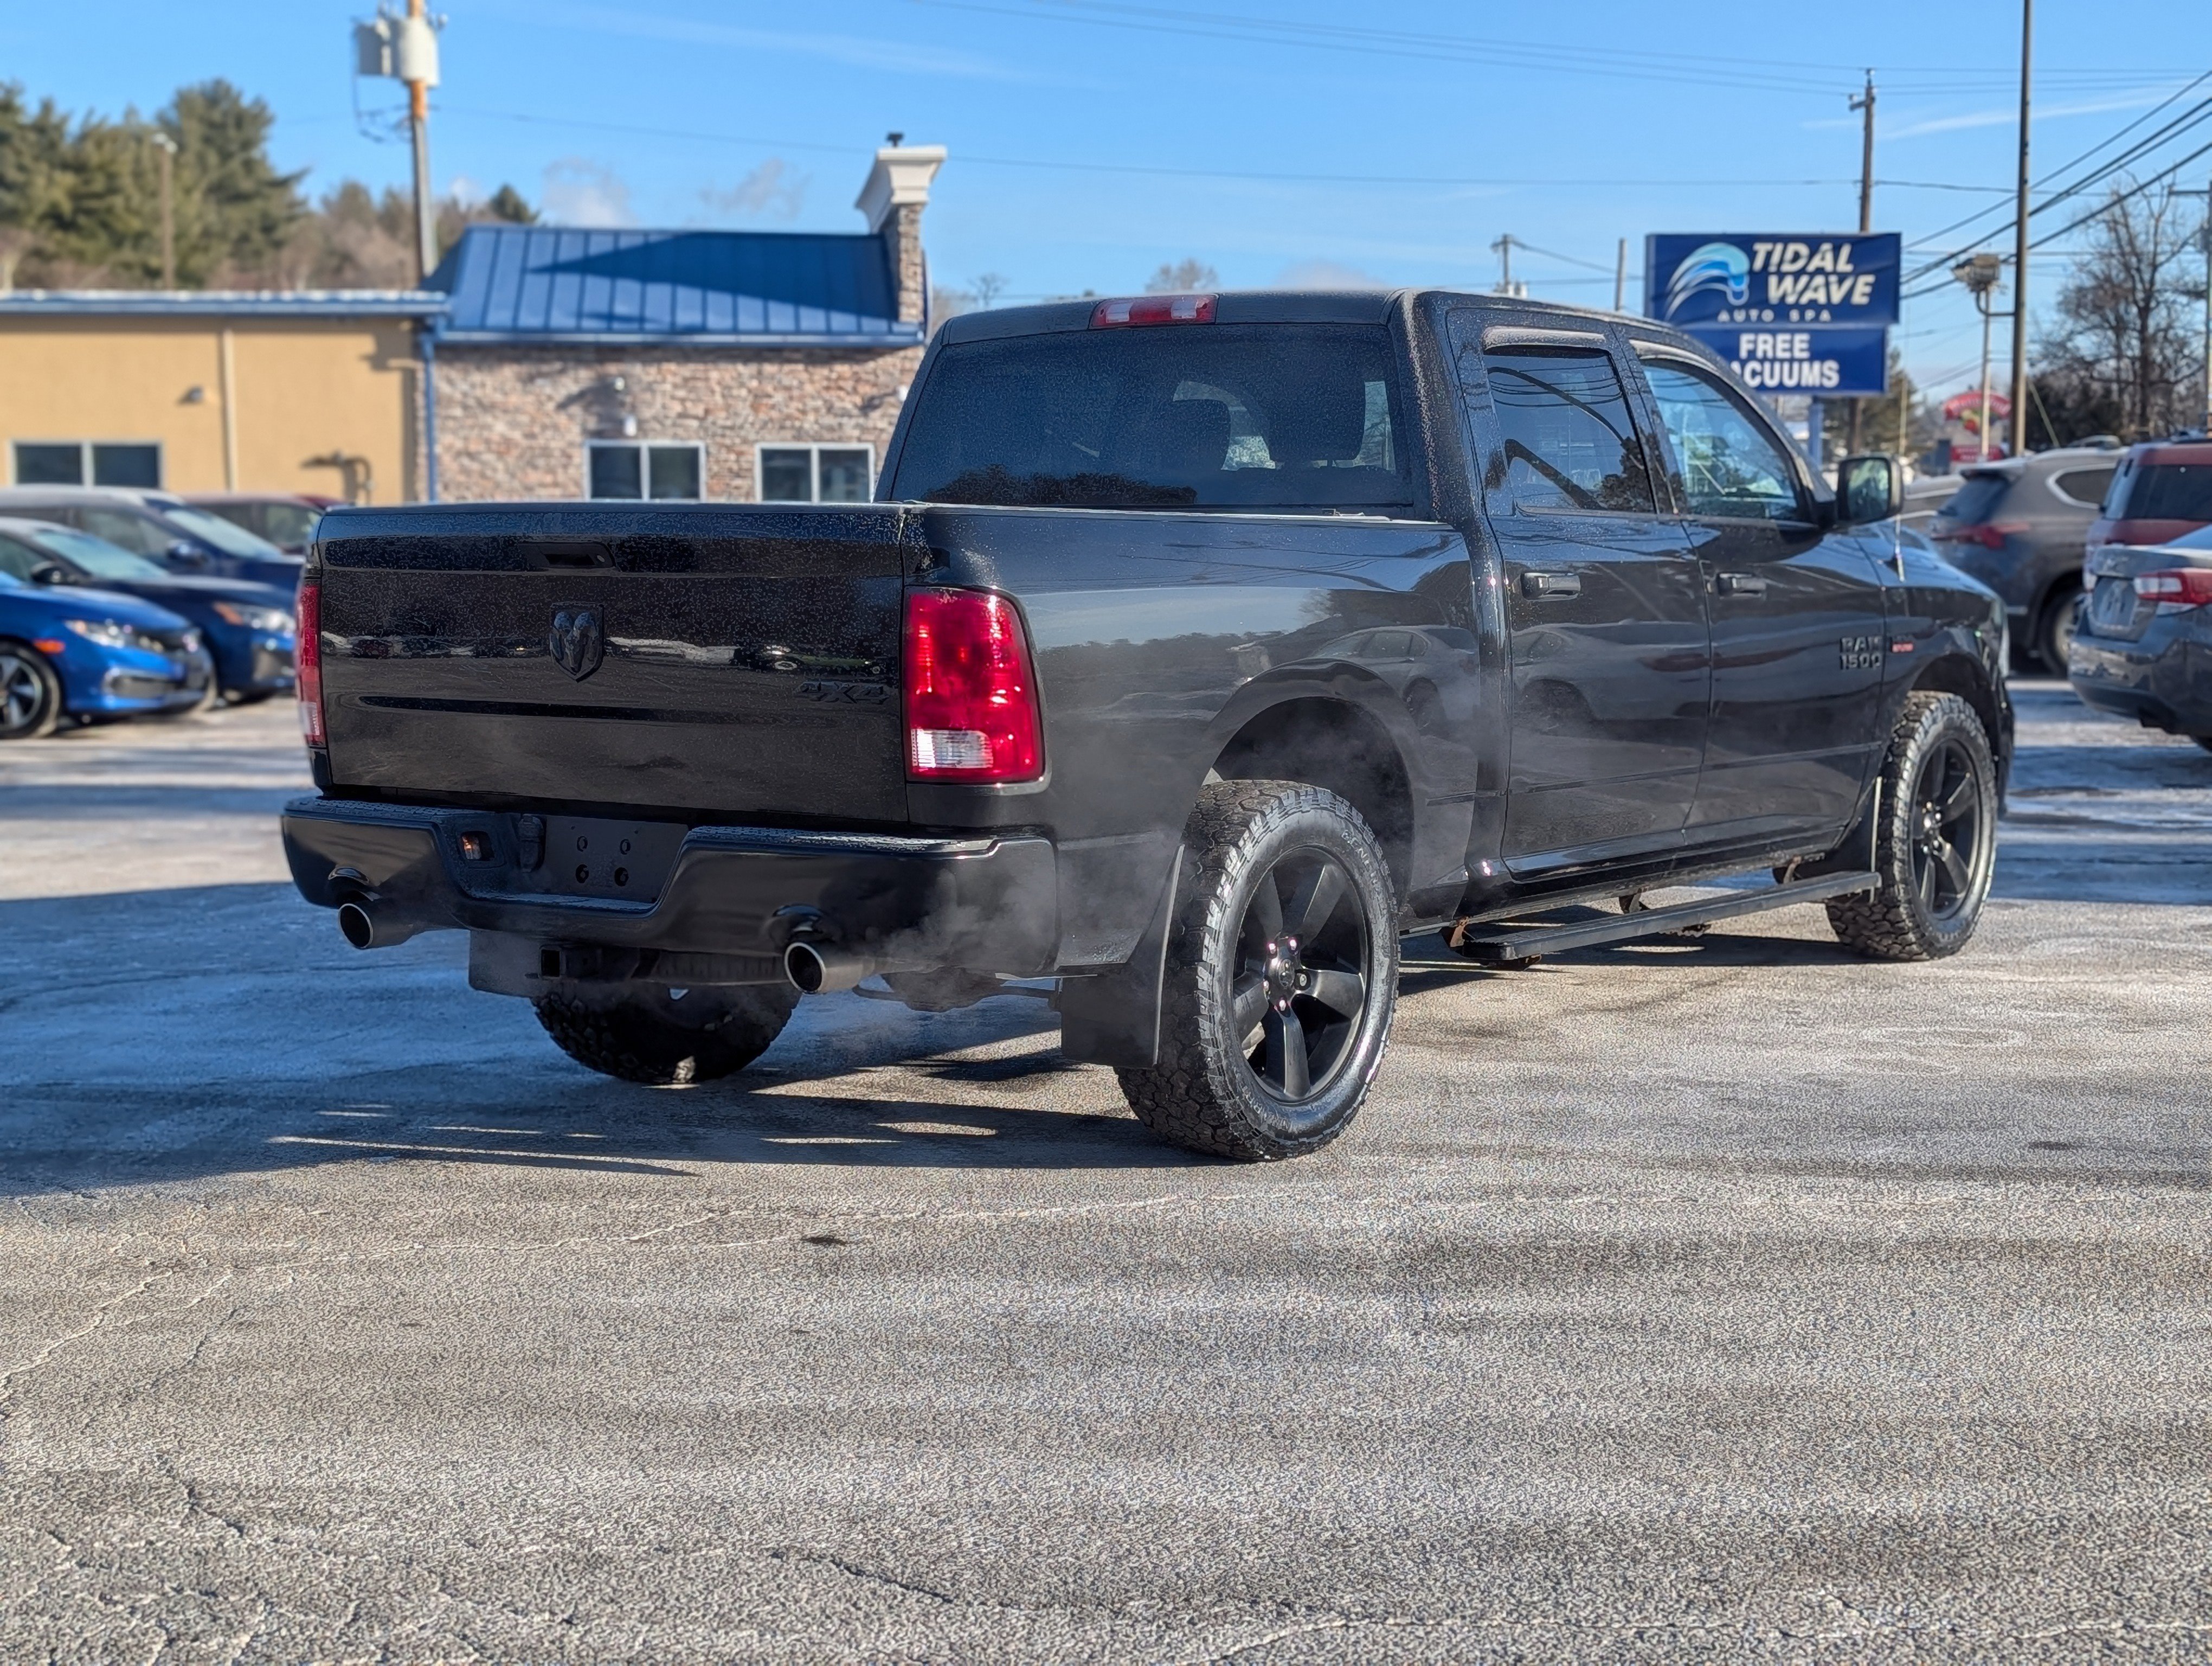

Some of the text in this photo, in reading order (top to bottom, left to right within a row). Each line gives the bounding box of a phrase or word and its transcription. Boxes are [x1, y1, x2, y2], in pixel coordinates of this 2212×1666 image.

[1752, 242, 1854, 272] TIDAL
[1767, 274, 1875, 305] WAVE
[1717, 309, 1831, 323] AUTO SPA
[1739, 333, 1811, 360] FREE
[1840, 652, 1882, 670] 1500
